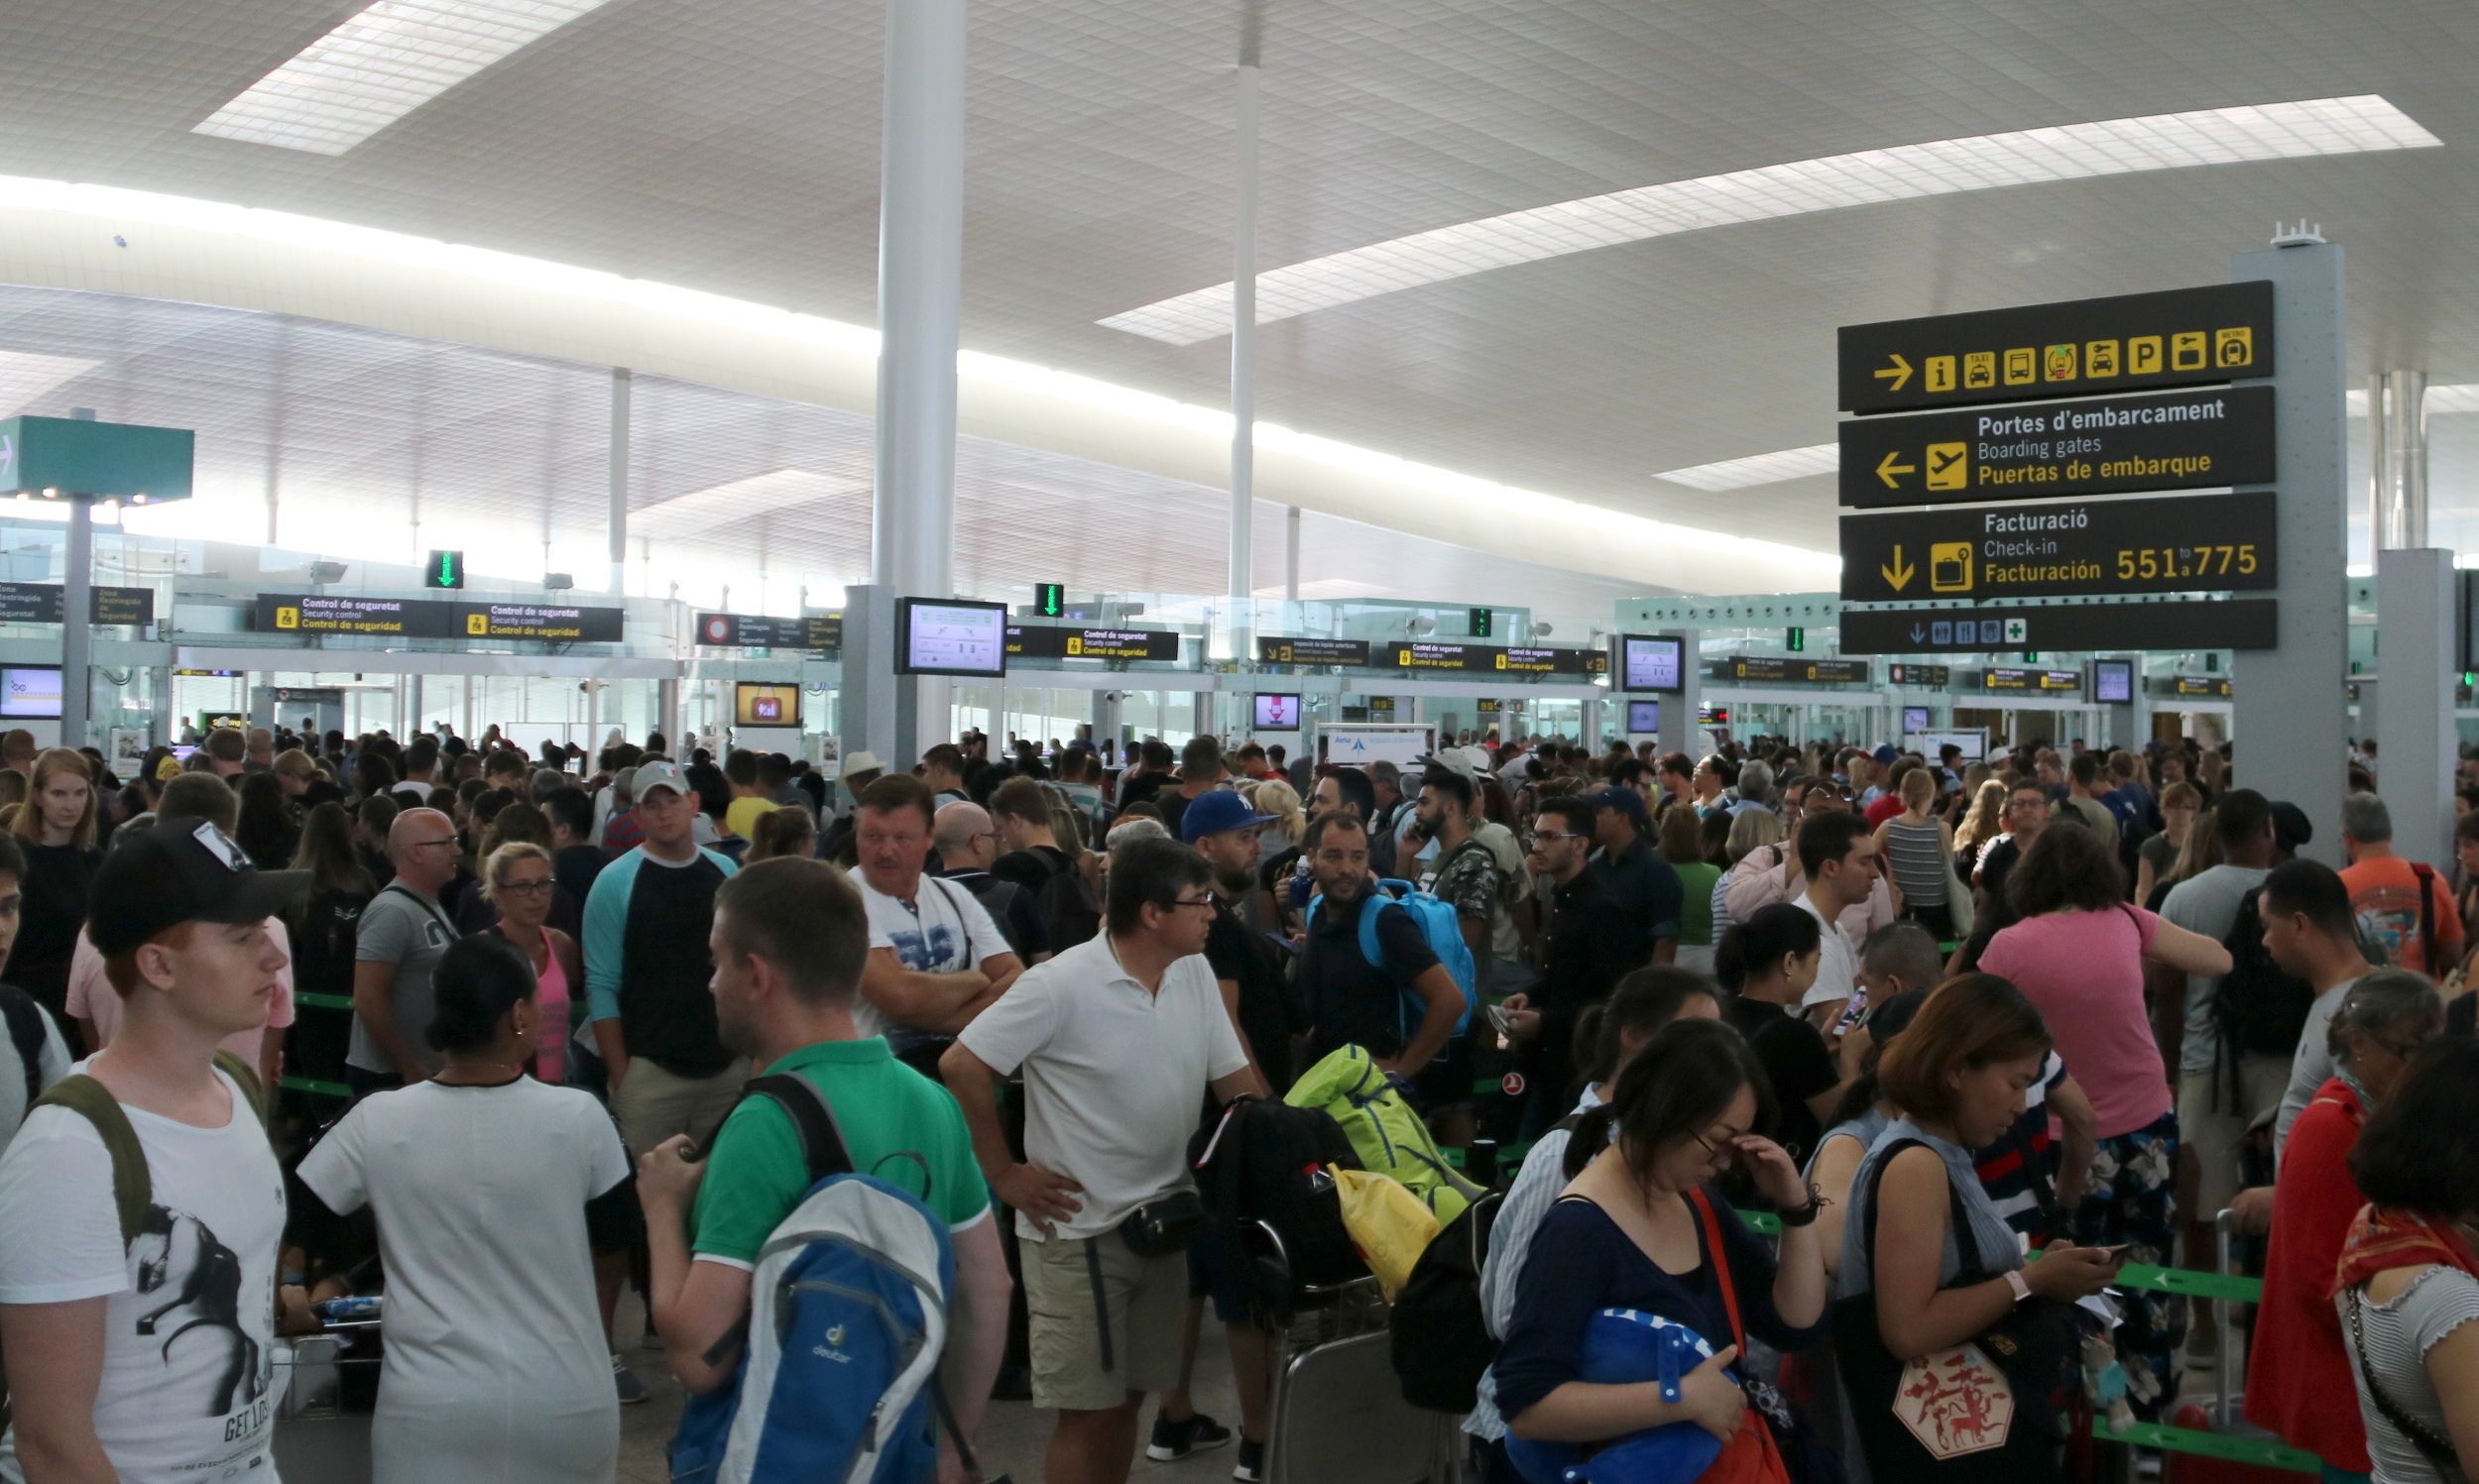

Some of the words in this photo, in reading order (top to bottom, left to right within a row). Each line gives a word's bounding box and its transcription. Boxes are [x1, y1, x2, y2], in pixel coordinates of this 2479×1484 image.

[1970, 354, 1990, 364] TAXI
[1978, 416, 2045, 436] Portes
[2053, 399, 2225, 431] d'embarcament
[1978, 440, 2049, 459] Boarding
[2056, 437, 2102, 458] gates
[1979, 464, 2059, 485] Puertas
[2066, 459, 2091, 479] de
[2100, 455, 2211, 477] embarque
[1985, 509, 2088, 532] Facturació
[1985, 538, 2057, 557] Check-in
[1985, 561, 2101, 582] Facturación
[2117, 548, 2178, 579] 551
[2181, 566, 2190, 576] a
[2193, 545, 2257, 575] 775
[302, 598, 338, 608] Control
[340, 600, 353, 609] de
[355, 602, 401, 611] seguretat
[302, 609, 333, 619] Security
[491, 605, 522, 615] Control
[524, 607, 535, 616] de
[538, 609, 579, 618] seguretat
[302, 619, 337, 628] Control
[340, 621, 352, 629] de
[355, 622, 402, 631] seguridad
[491, 616, 519, 625] Security
[490, 626, 522, 634] Control
[538, 628, 579, 637] seguridad
[1084, 630, 1107, 638] Control
[812, 1345, 852, 1364] deuter
[224, 1410, 249, 1442] GET
[252, 1399, 271, 1428] LOS
